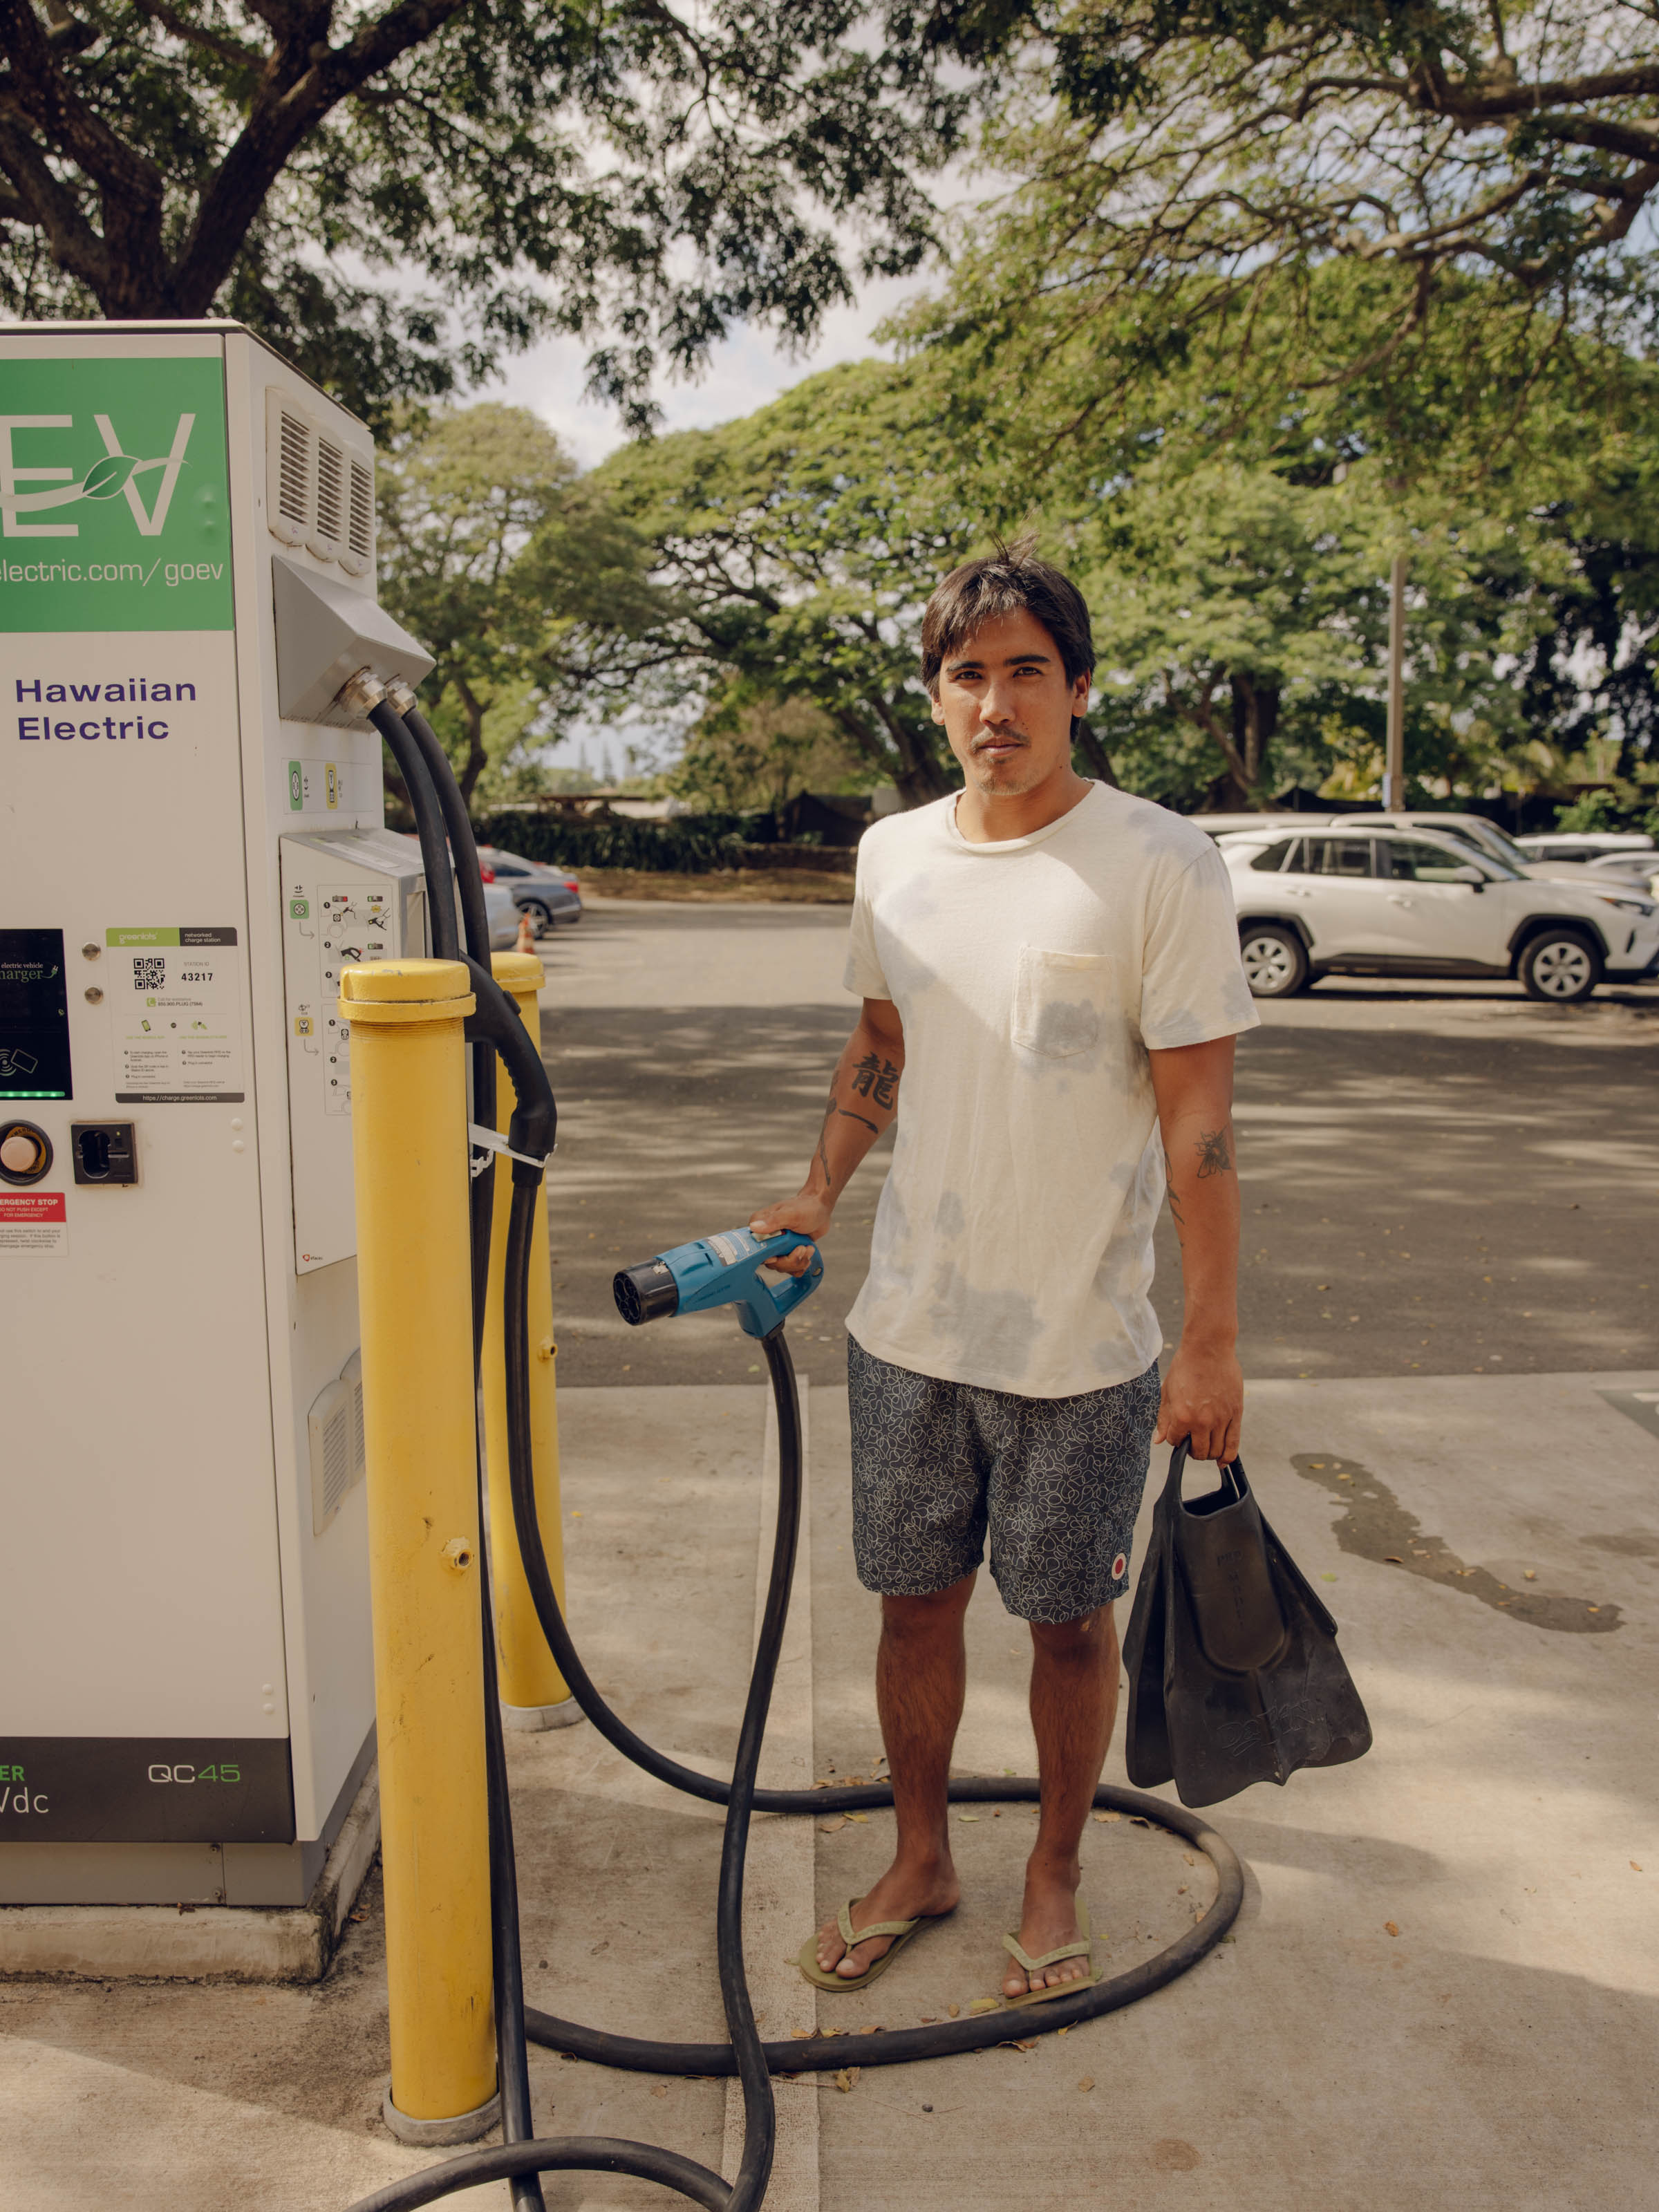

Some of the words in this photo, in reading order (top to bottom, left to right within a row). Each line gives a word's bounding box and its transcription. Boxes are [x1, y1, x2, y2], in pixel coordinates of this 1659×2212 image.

[0, 413, 196, 537] EV
[0, 557, 223, 587] lectric.com/goev
[16, 677, 196, 702] Hawaiian
[18, 715, 169, 740] Electric
[119, 932, 156, 944] greenlots
[181, 973, 214, 982] 43217
[148, 1764, 241, 1783] QC45
